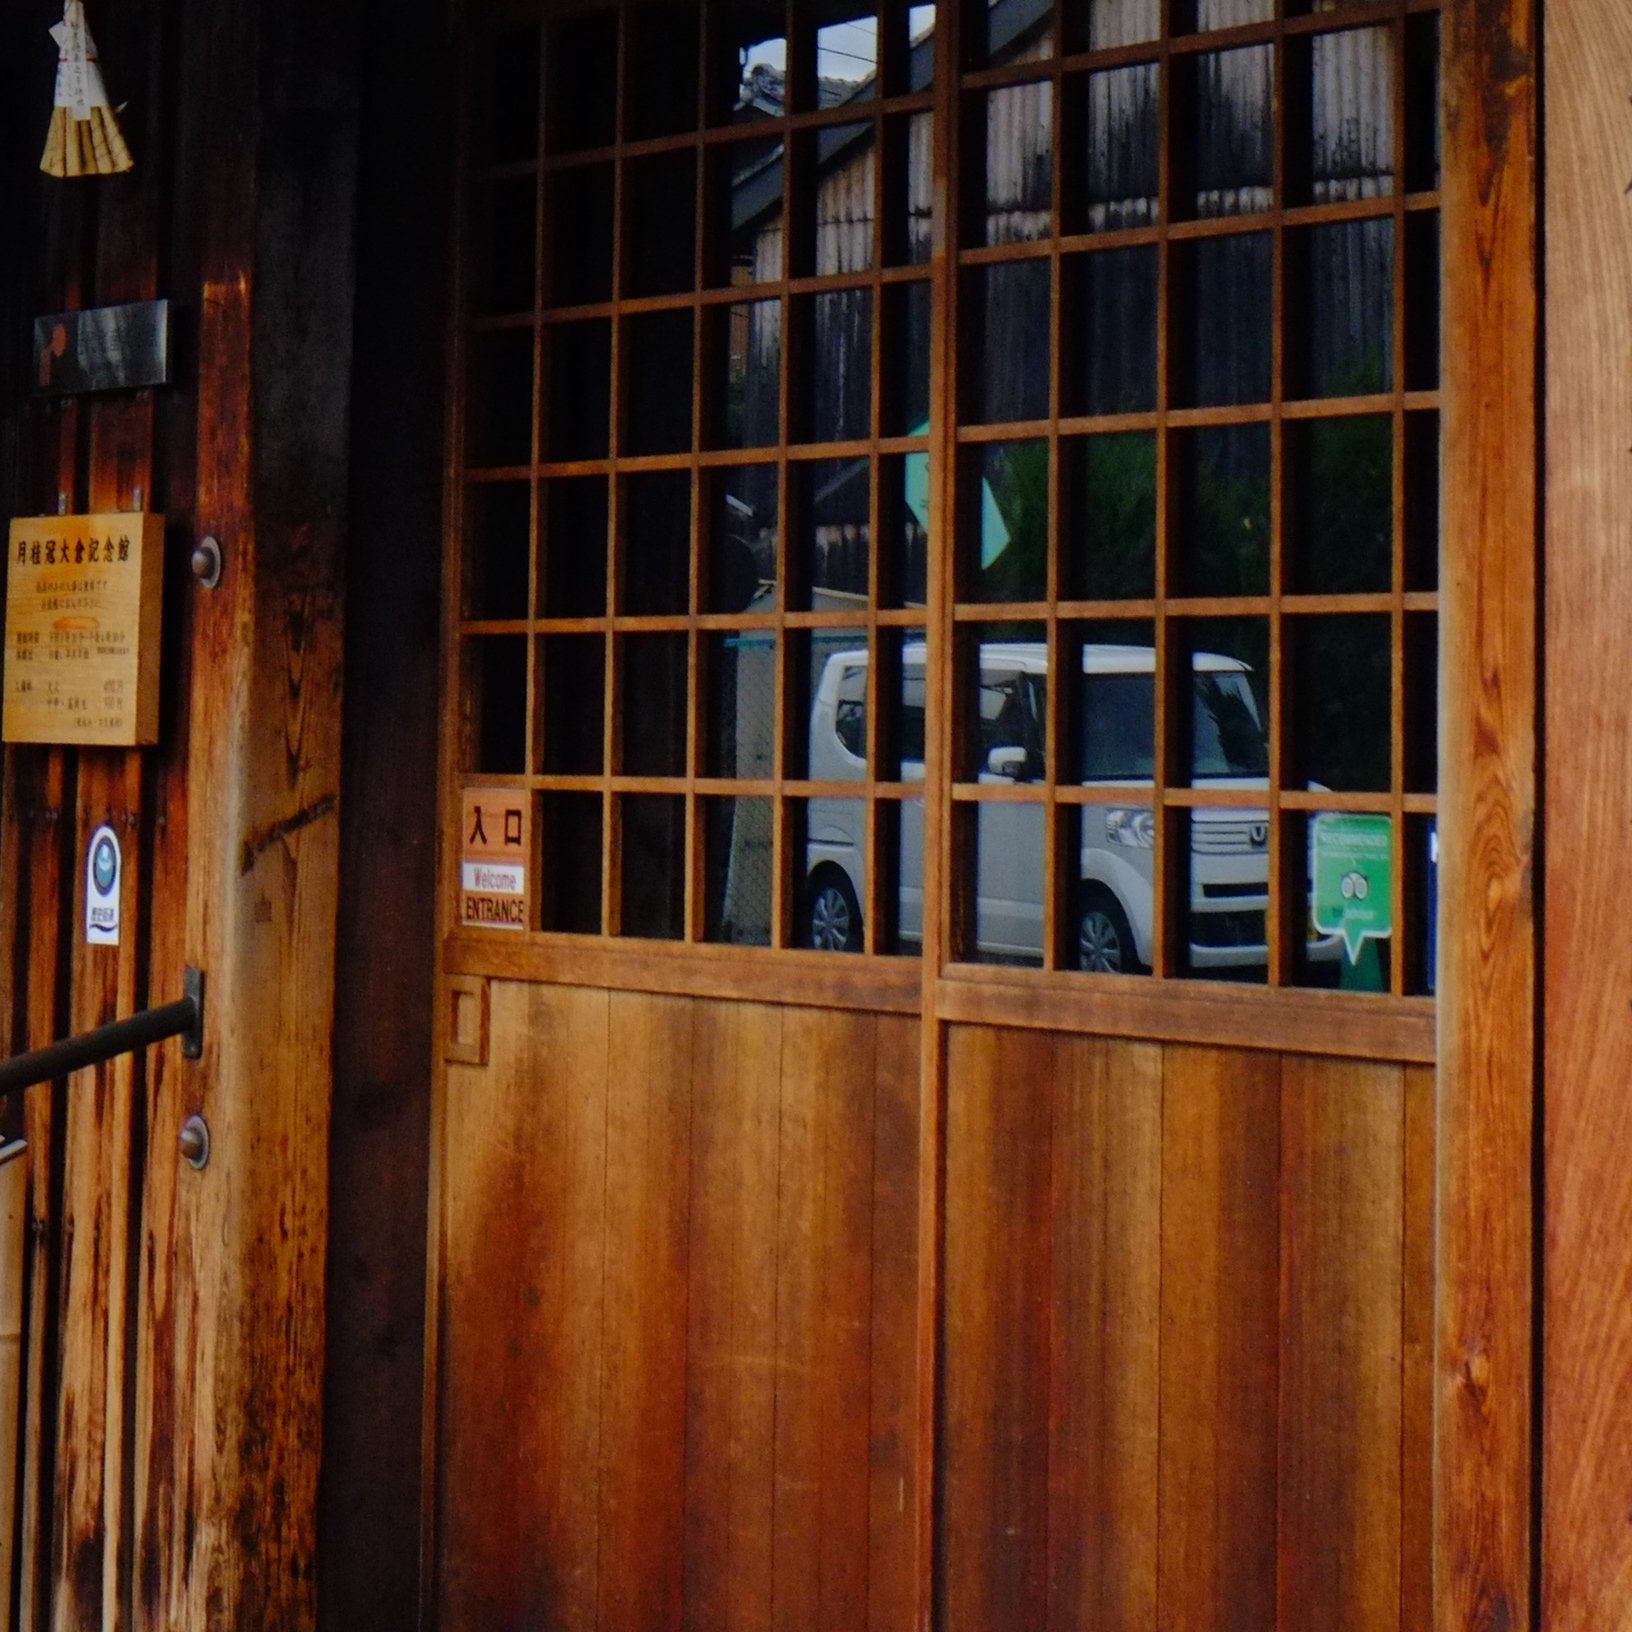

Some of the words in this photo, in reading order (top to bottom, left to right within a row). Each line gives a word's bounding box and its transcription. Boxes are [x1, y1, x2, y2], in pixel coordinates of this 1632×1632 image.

[16, 535, 131, 566] 月桂冠大倉記念館
[469, 805, 522, 846] 入口
[473, 867, 517, 891] Welcome
[466, 897, 524, 923] ENTRANCE
